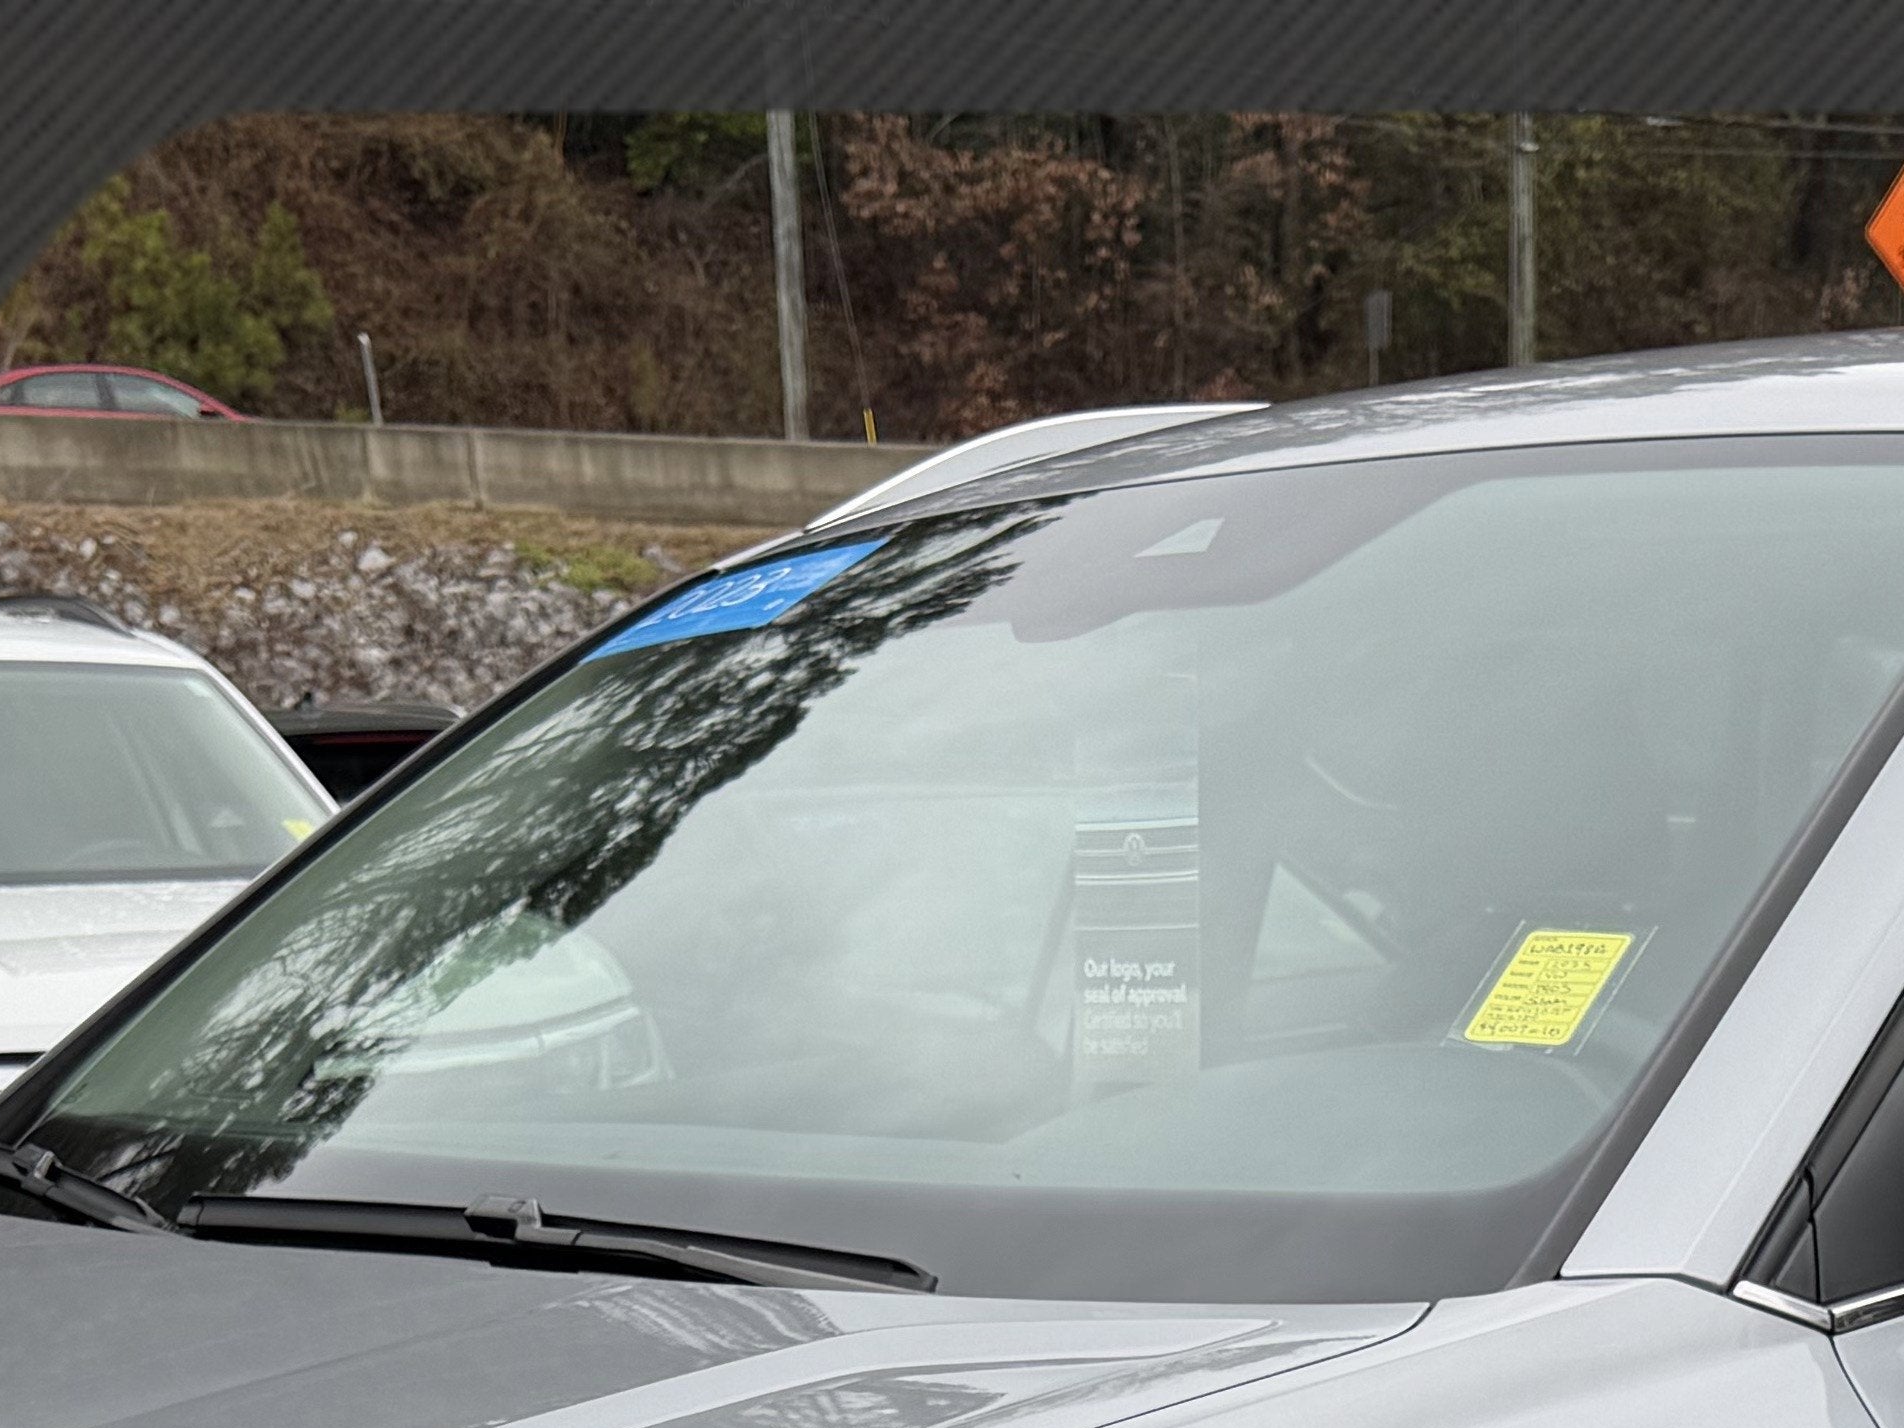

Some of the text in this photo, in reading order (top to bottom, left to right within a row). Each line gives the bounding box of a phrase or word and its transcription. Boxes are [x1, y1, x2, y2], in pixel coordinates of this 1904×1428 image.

[1084, 958, 1108, 978] Our
[1144, 960, 1176, 981] your
[1084, 983, 1110, 1003] seal
[1111, 983, 1126, 1003] of
